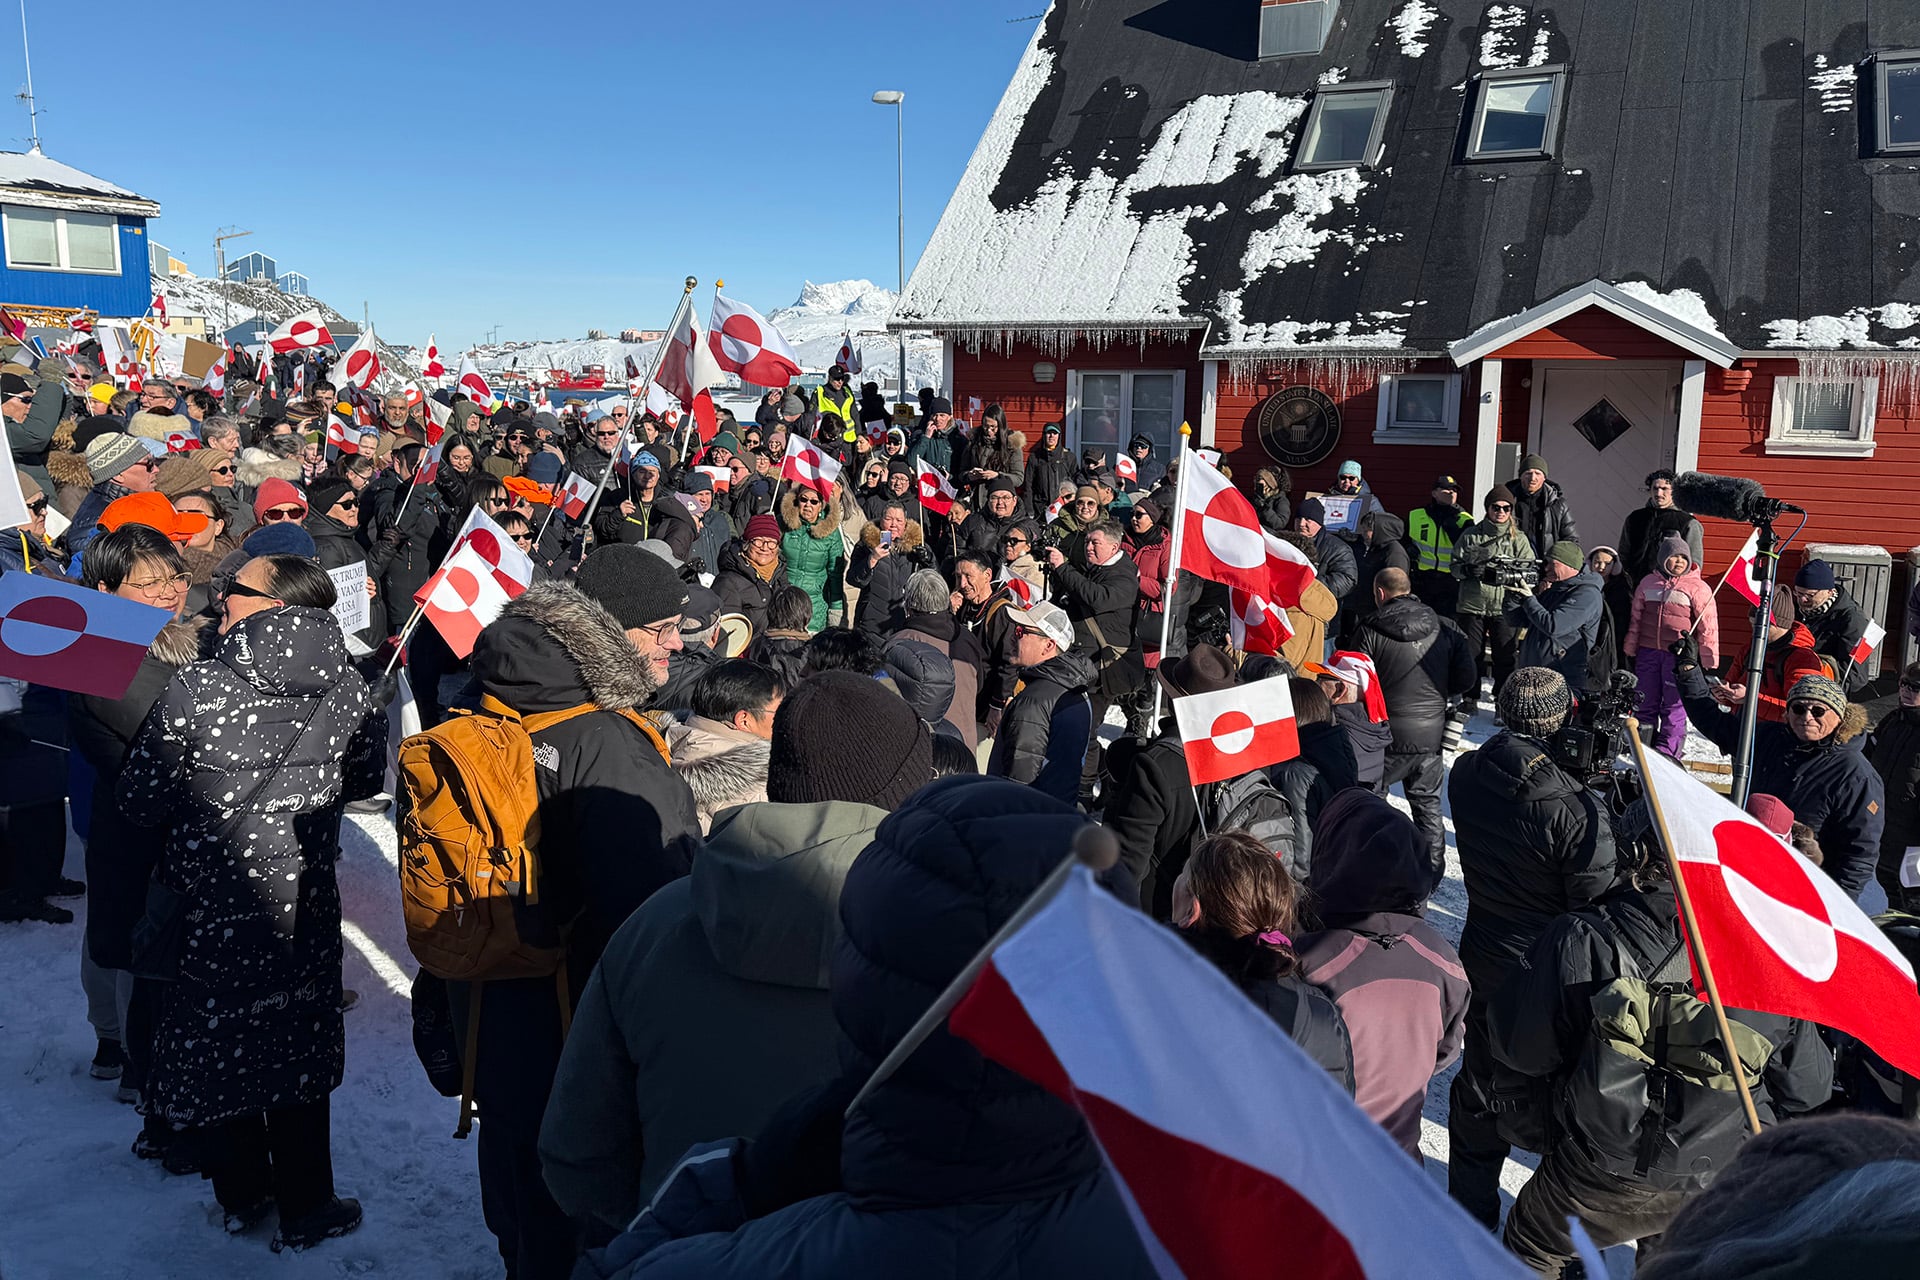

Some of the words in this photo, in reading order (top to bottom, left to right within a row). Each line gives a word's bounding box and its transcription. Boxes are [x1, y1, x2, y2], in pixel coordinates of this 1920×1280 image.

[1262, 399, 1280, 426] UNITED
[1280, 389, 1307, 401] STATES
[1286, 455, 1309, 464] NUUK
[340, 566, 364, 582] TRUMP
[341, 581, 364, 597] VANCE
[342, 599, 356, 613] USA
[195, 697, 227, 715] emnitz
[542, 742, 555, 753] THE
